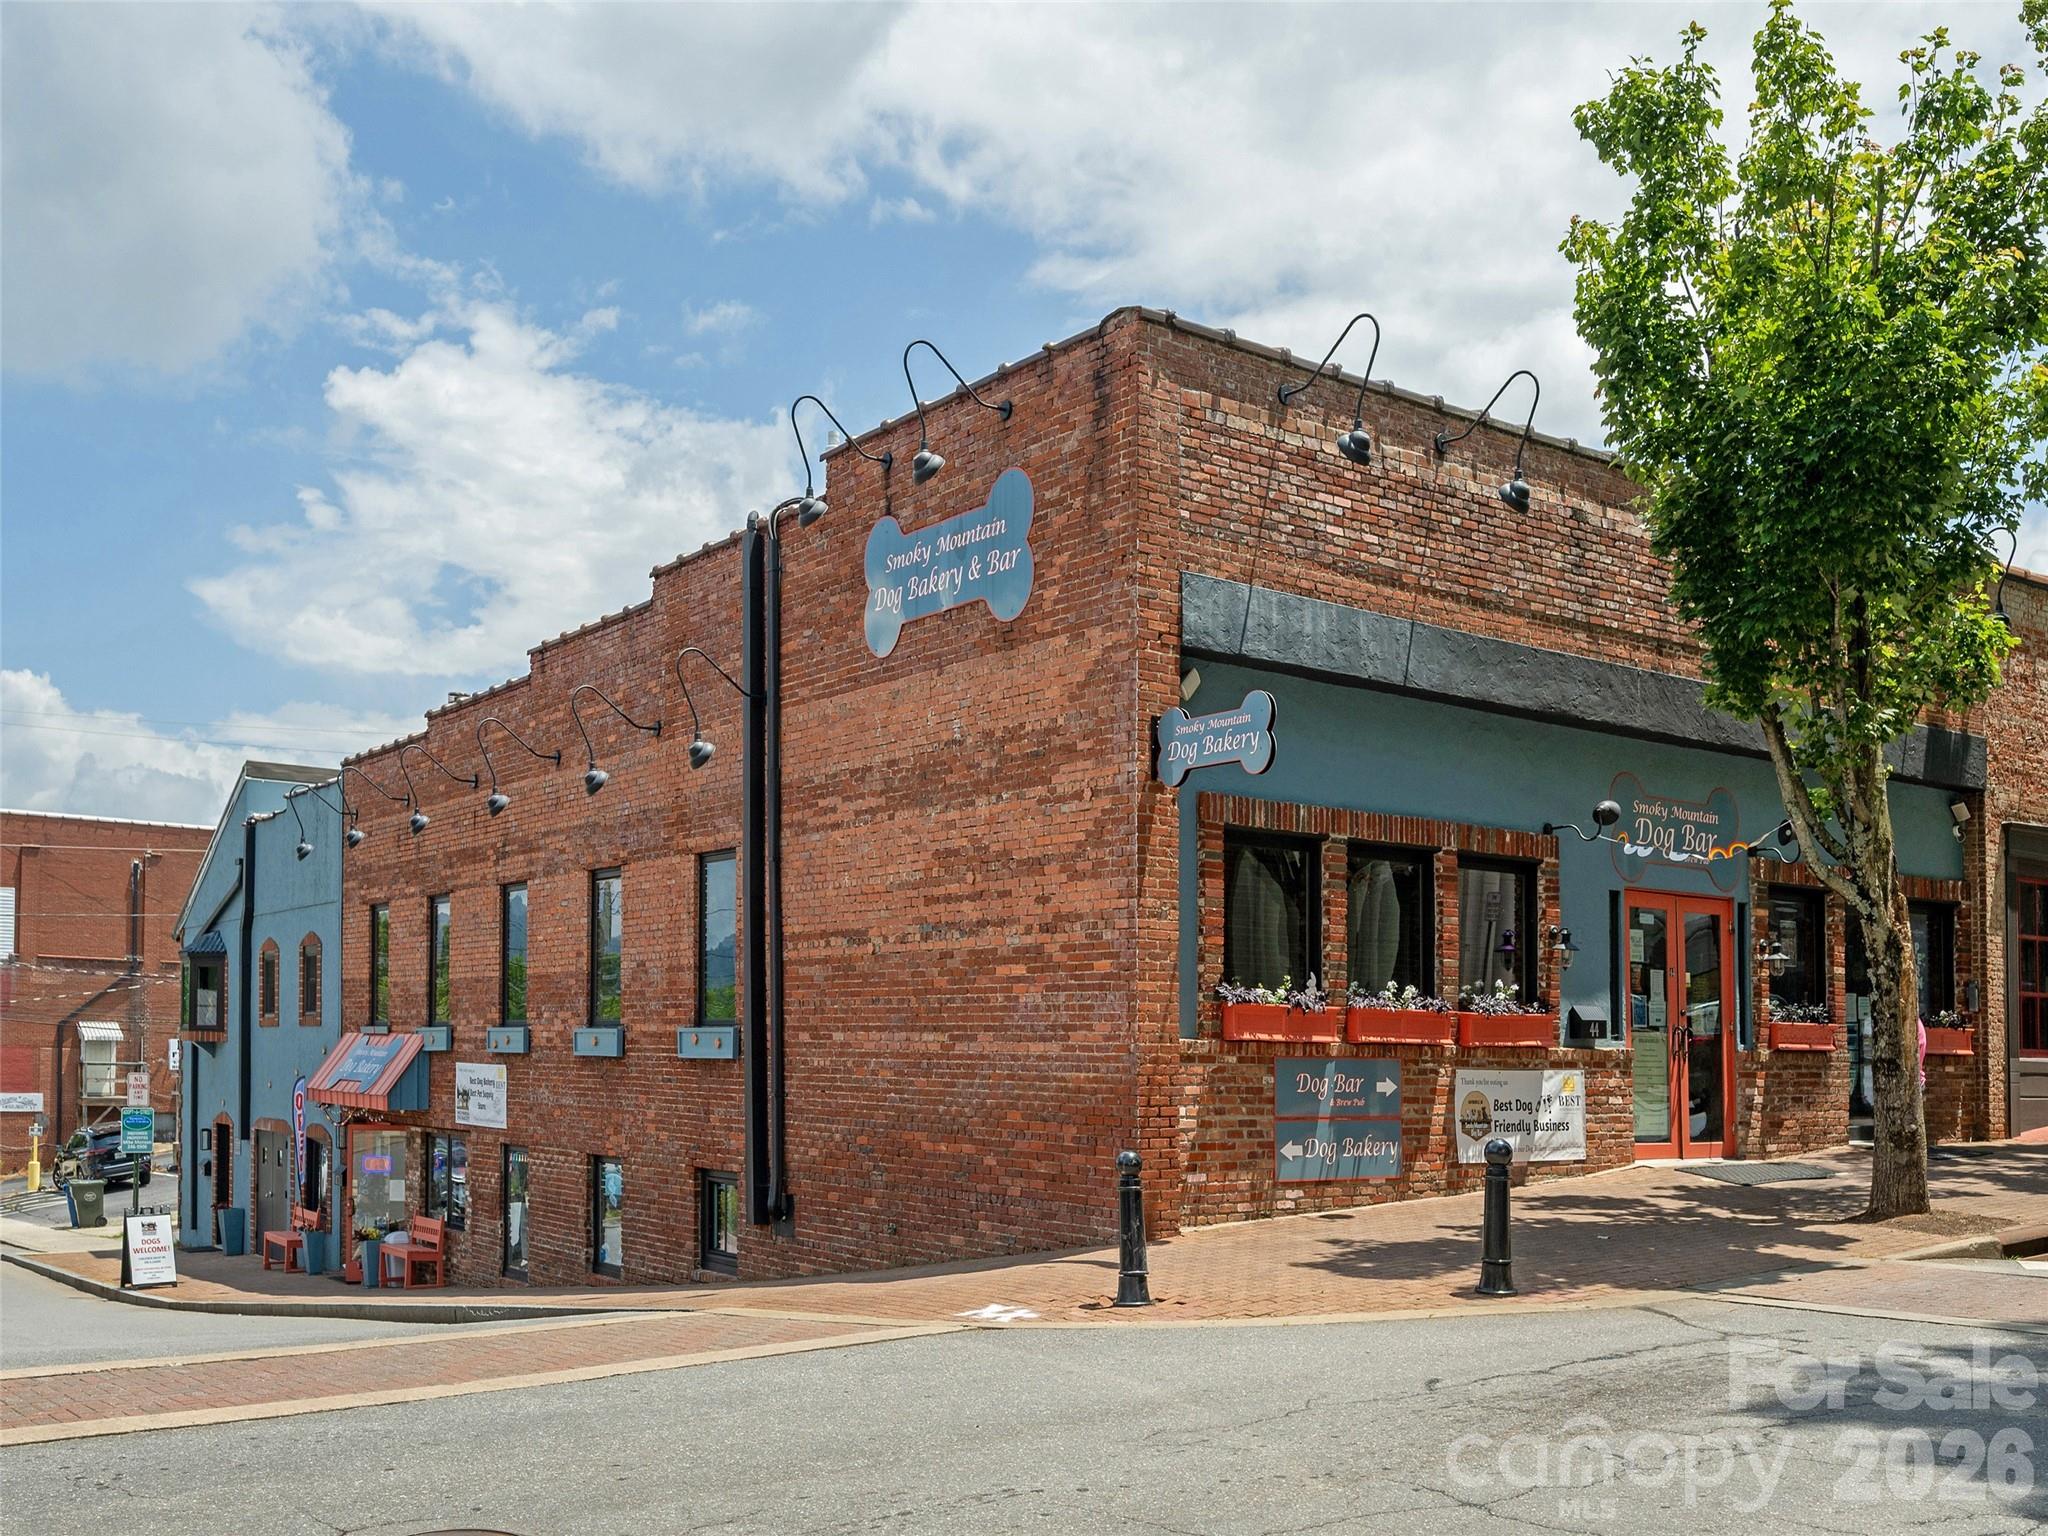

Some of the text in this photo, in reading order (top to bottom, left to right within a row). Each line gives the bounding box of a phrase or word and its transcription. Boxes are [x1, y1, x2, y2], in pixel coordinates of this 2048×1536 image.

[885, 517, 1007, 574] Smoky Mountain
[875, 548, 1022, 614] Dog Bakery & Bar
[1175, 712, 1251, 736] Smoky Mountain
[1168, 729, 1260, 765] Dog Bakery
[1633, 800, 1719, 825] Smoky Mountain
[1635, 817, 1718, 859] Dog Bar
[1589, 1021, 1599, 1037] 44
[353, 1059, 382, 1079] Bakery
[1296, 1073, 1364, 1100] Dog Bar
[1493, 1099, 1533, 1114] Best Dog
[1558, 1095, 1581, 1107] BEST
[1494, 1119, 1531, 1135] Friendly
[1534, 1118, 1570, 1132] Business
[1304, 1134, 1398, 1165] Dog Bakery
[133, 1245, 170, 1254] WELCOME!
